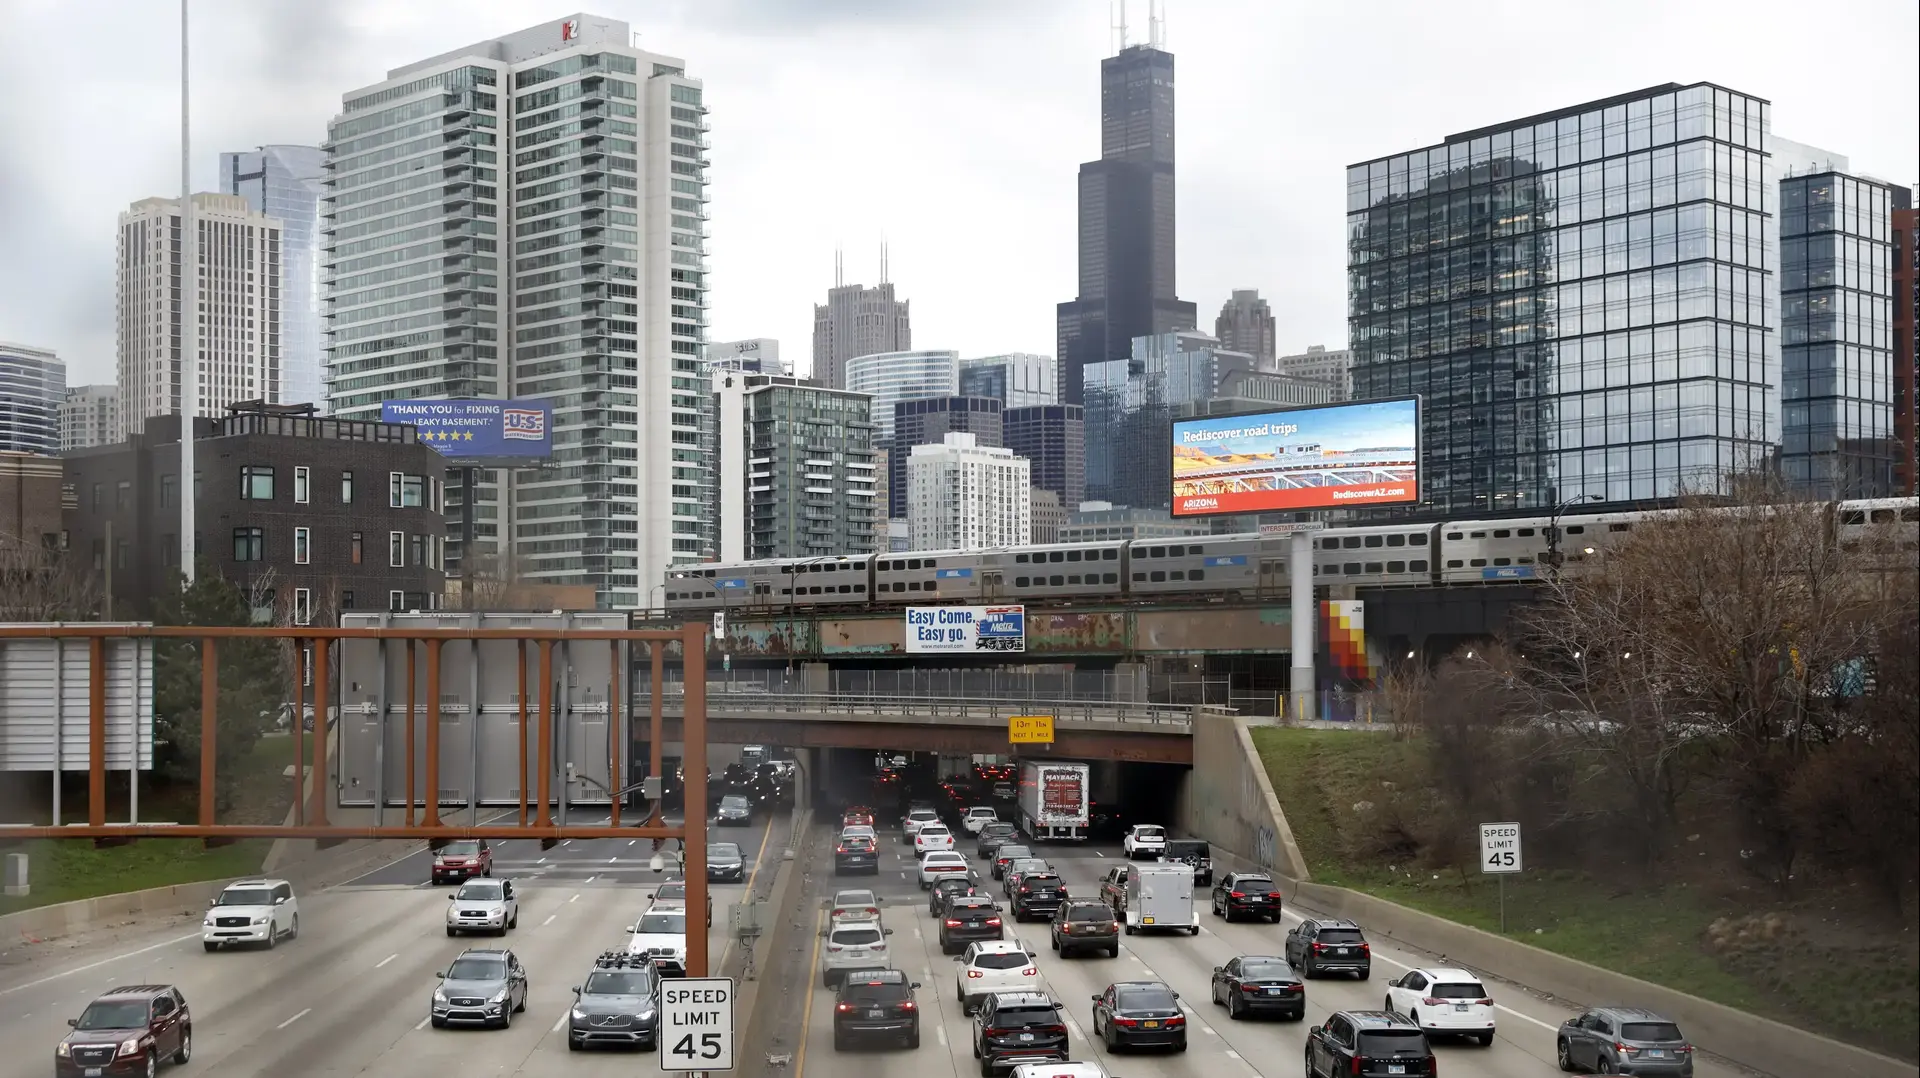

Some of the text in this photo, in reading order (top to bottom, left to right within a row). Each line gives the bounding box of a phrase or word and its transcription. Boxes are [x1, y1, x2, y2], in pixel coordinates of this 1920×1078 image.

[430, 405, 452, 414] YOU
[454, 405, 465, 414] for
[466, 405, 500, 414] FIXING
[413, 418, 441, 426] LEAKY
[1183, 422, 1298, 443] Rediscover road trips
[1333, 488, 1405, 499] RediscoverAZ.com
[1183, 498, 1218, 507] ARIZONA
[908, 609, 976, 626] Easy Come.
[990, 622, 1014, 632] Metra
[918, 626, 967, 642] Easy go.
[1484, 829, 1517, 837] SPEED
[1487, 840, 1513, 849] LIMIT
[1488, 852, 1514, 866] 45
[666, 990, 727, 1004] SPEED
[673, 1011, 720, 1026] LIMIT
[672, 1033, 722, 1060] 45
